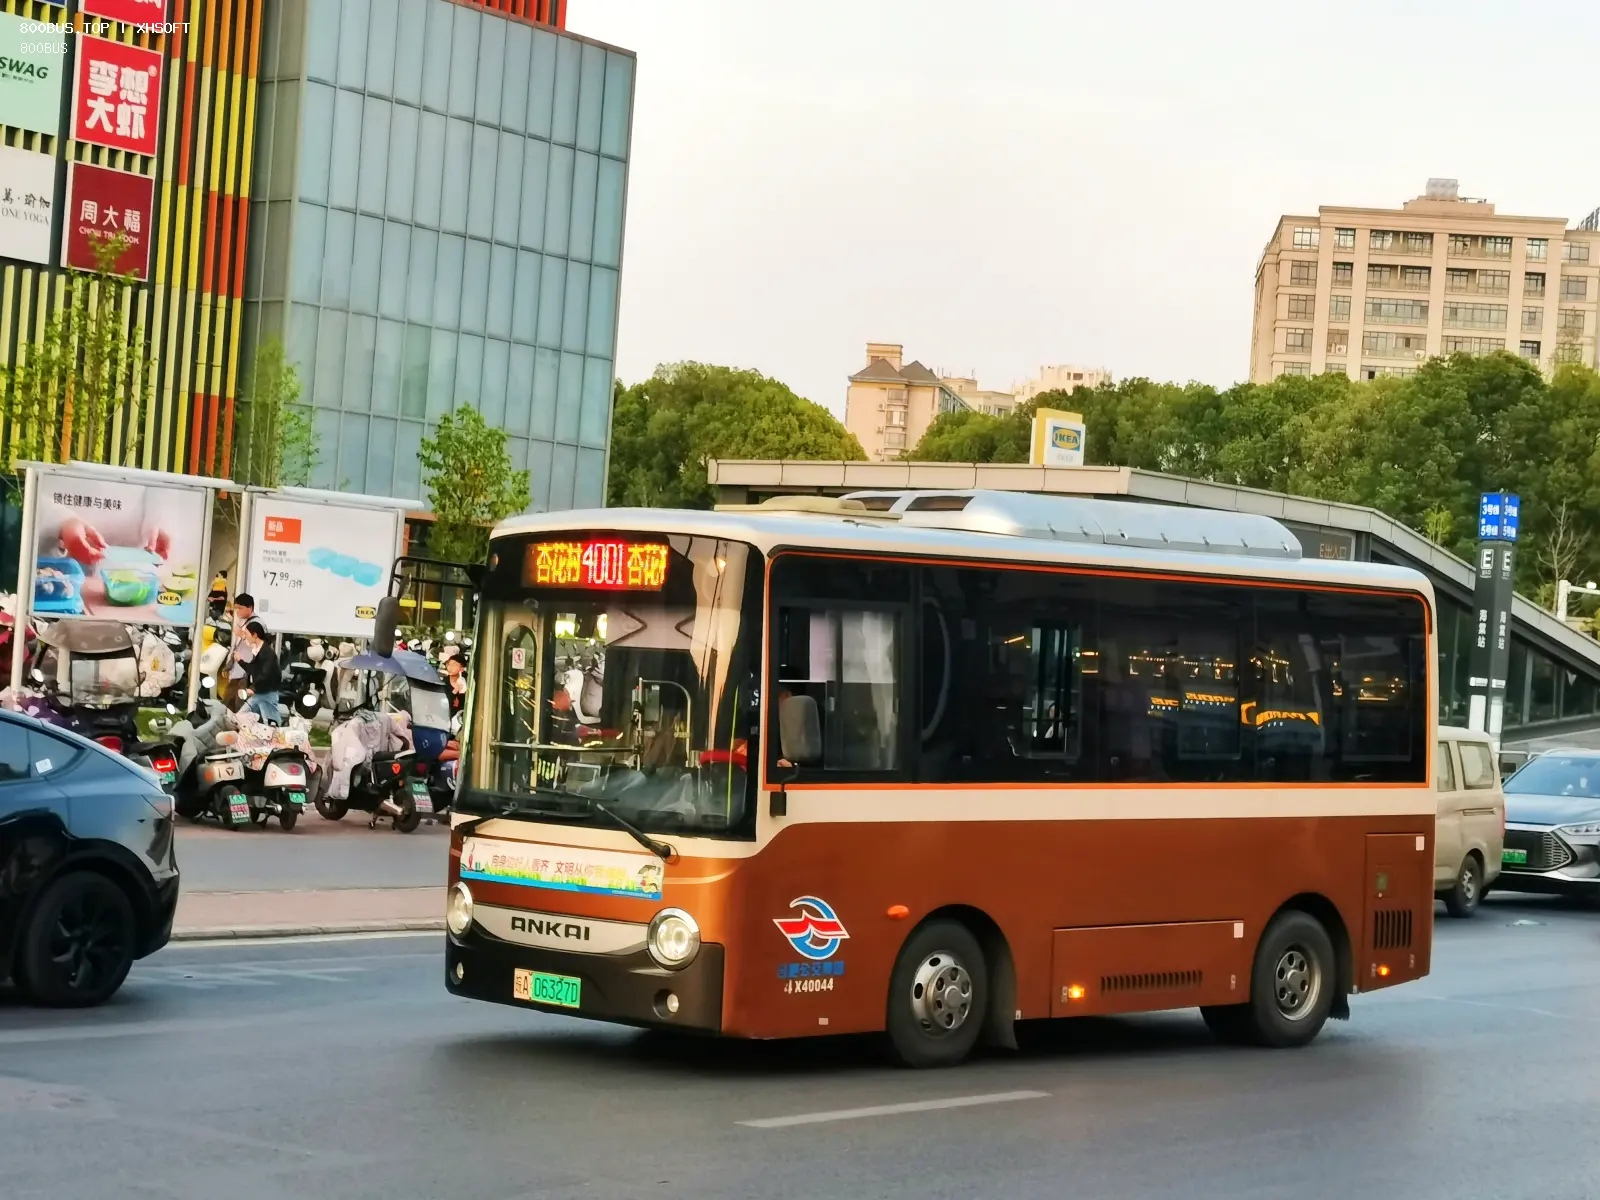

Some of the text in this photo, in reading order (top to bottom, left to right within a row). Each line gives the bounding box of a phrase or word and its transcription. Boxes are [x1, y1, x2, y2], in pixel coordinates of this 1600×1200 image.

[0, 56, 49, 79] SWAG
[85, 96, 147, 140] 大虾
[23, 211, 49, 226] YOGA
[80, 199, 141, 233] 周大福
[1054, 432, 1078, 445] IKEA
[53, 491, 123, 511] 锁住健康与美味
[536, 542, 582, 583] 杏花村
[581, 543, 624, 585] 4001
[511, 916, 590, 941] ANKAI
